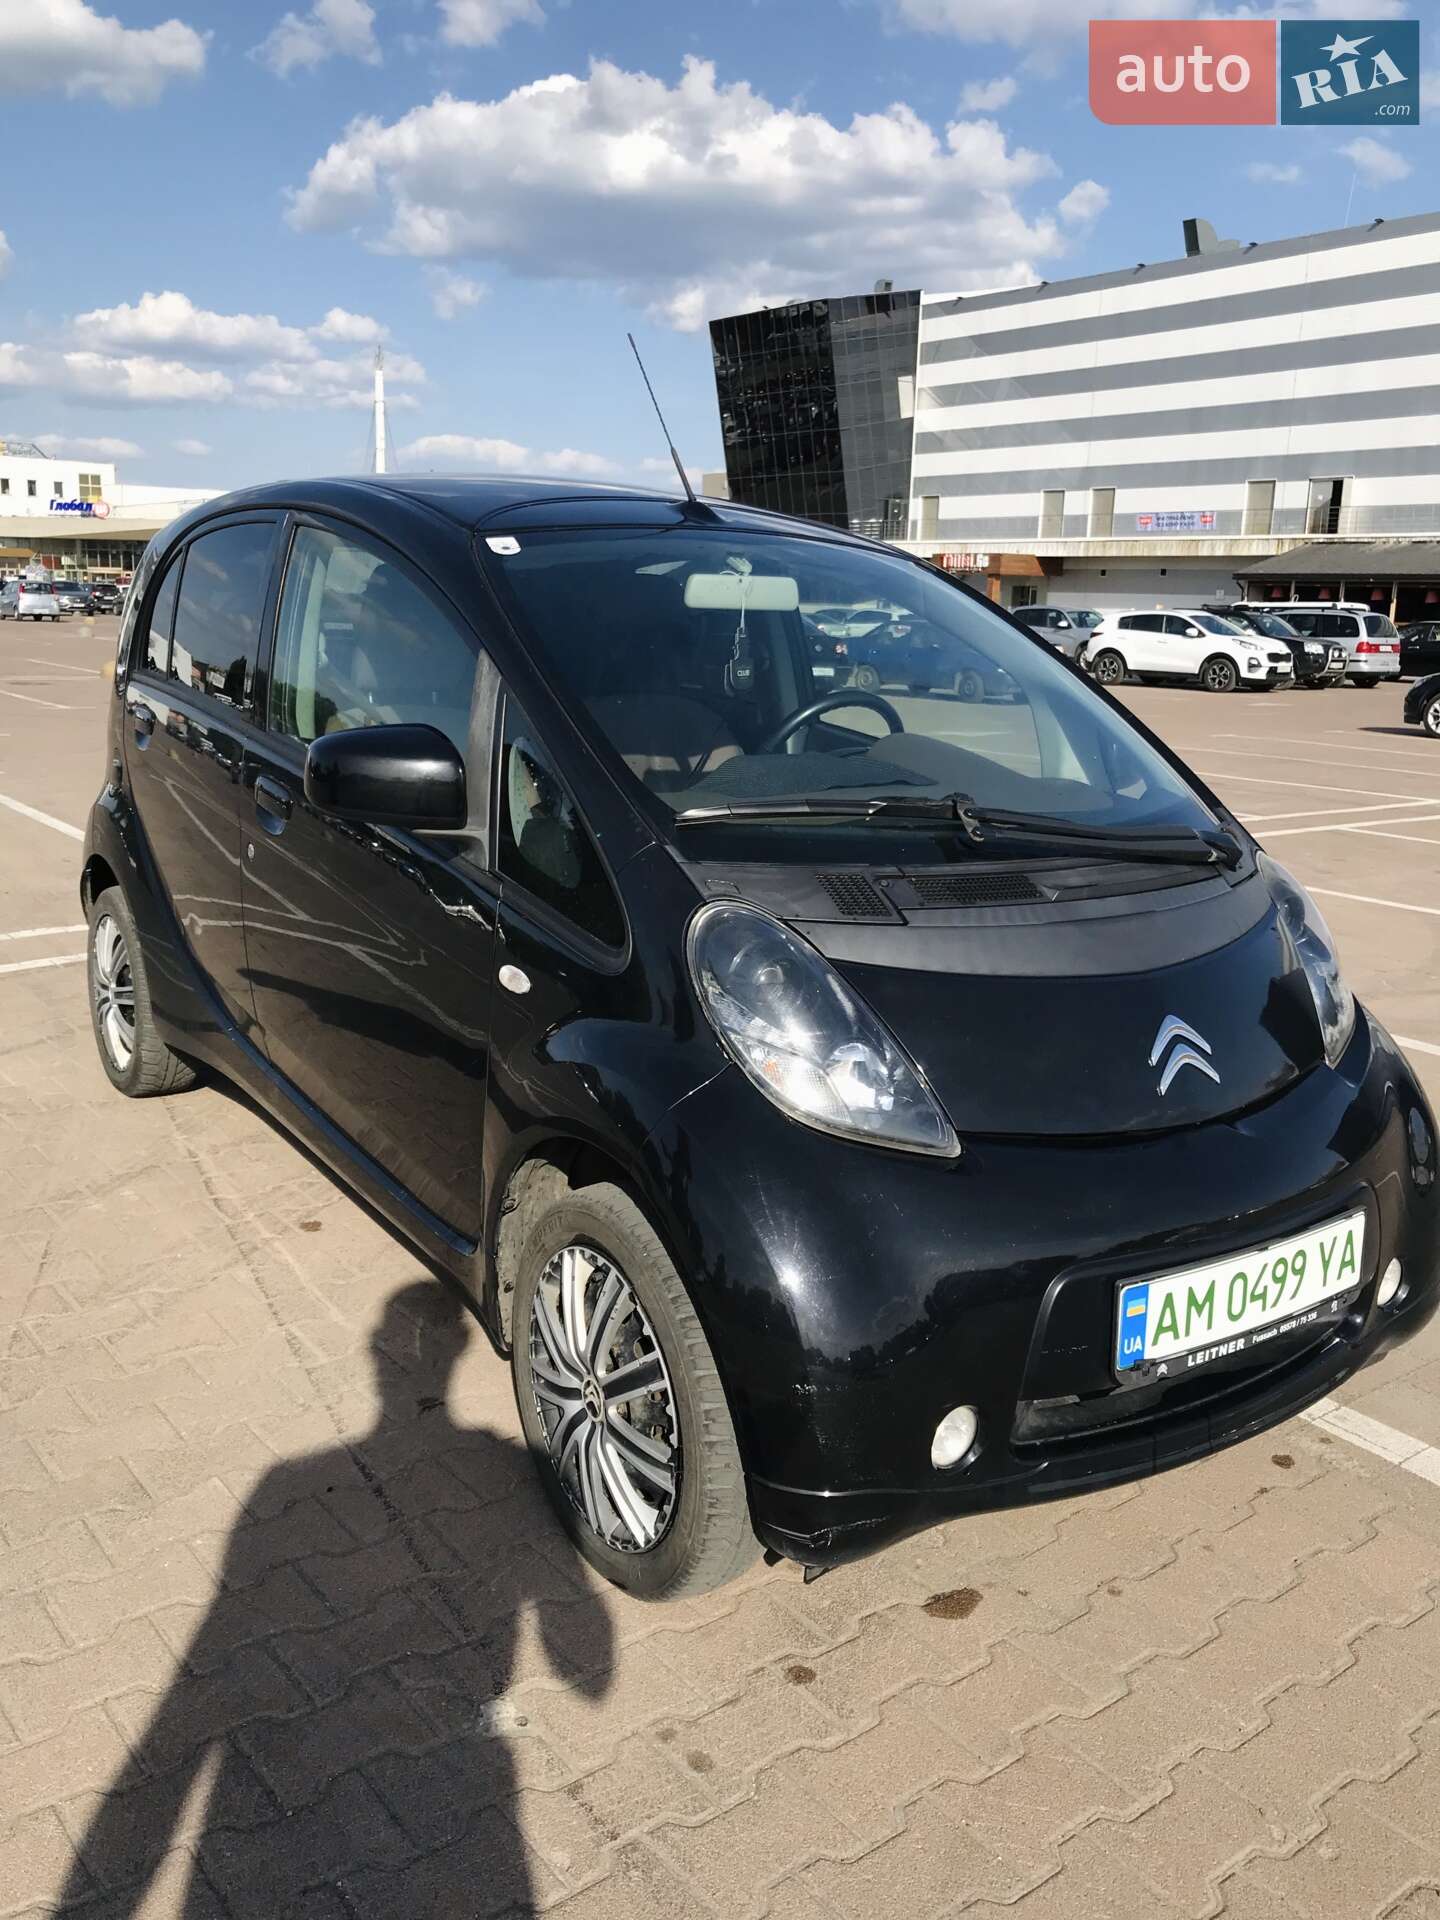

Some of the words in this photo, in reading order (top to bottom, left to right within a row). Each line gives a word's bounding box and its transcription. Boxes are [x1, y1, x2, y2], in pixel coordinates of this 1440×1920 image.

[1151, 1279, 1216, 1346] AM
[1227, 1249, 1307, 1322] 0499
[1319, 1230, 1356, 1287] YA
[1124, 1335, 1143, 1354] UA
[1187, 1338, 1246, 1367] LEITNER
